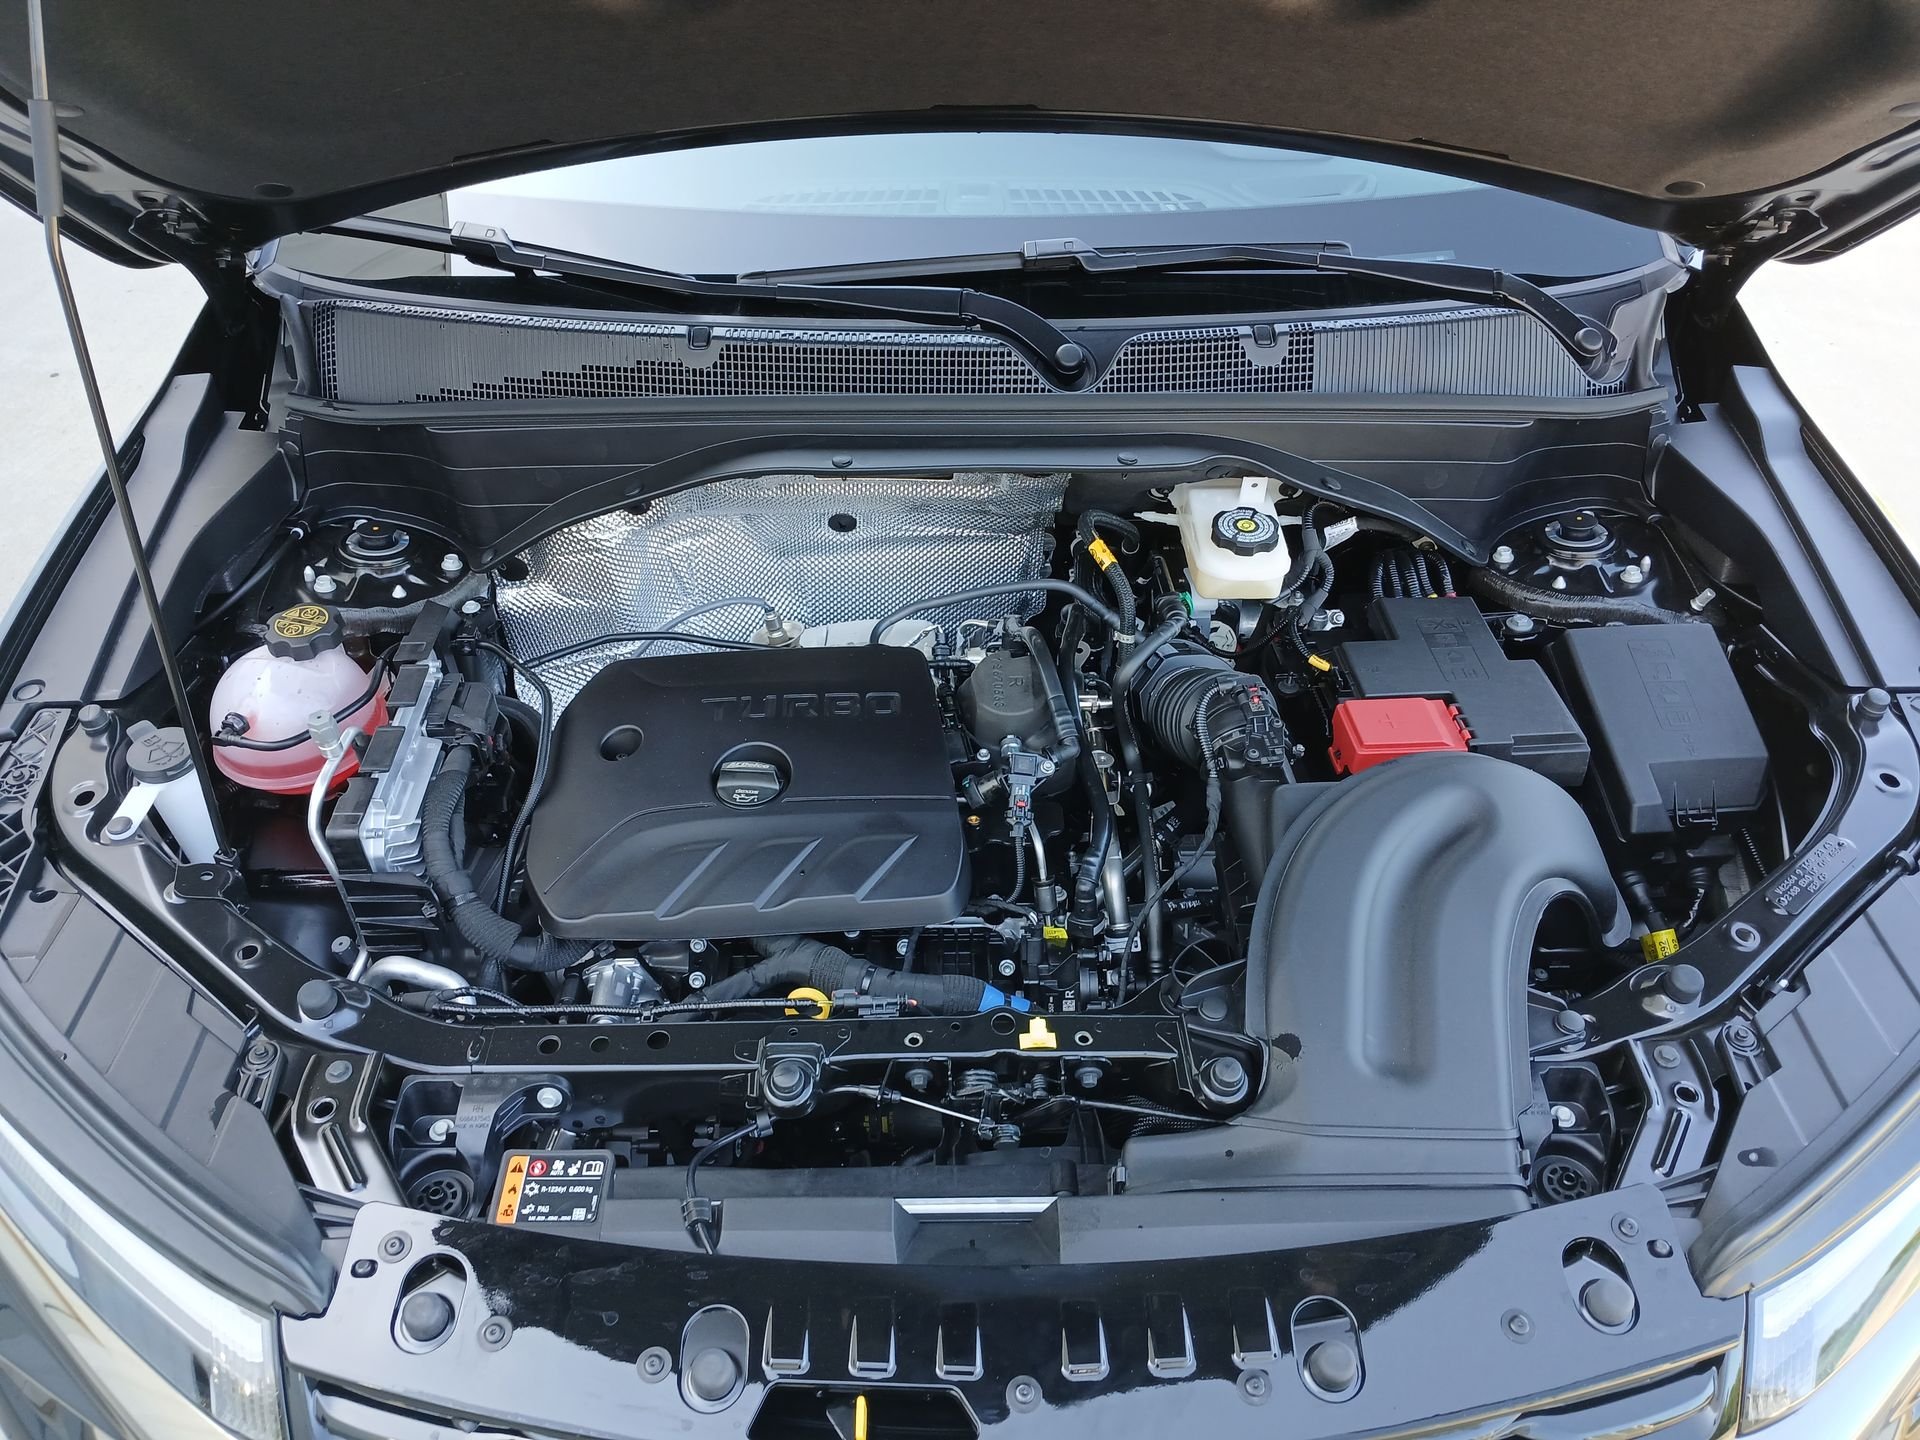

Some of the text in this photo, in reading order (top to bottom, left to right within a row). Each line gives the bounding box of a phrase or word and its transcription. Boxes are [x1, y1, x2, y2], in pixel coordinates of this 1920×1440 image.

[701, 692, 901, 721] TURBO
[1065, 990, 1075, 999] R
[536, 1205, 550, 1213] PAG
